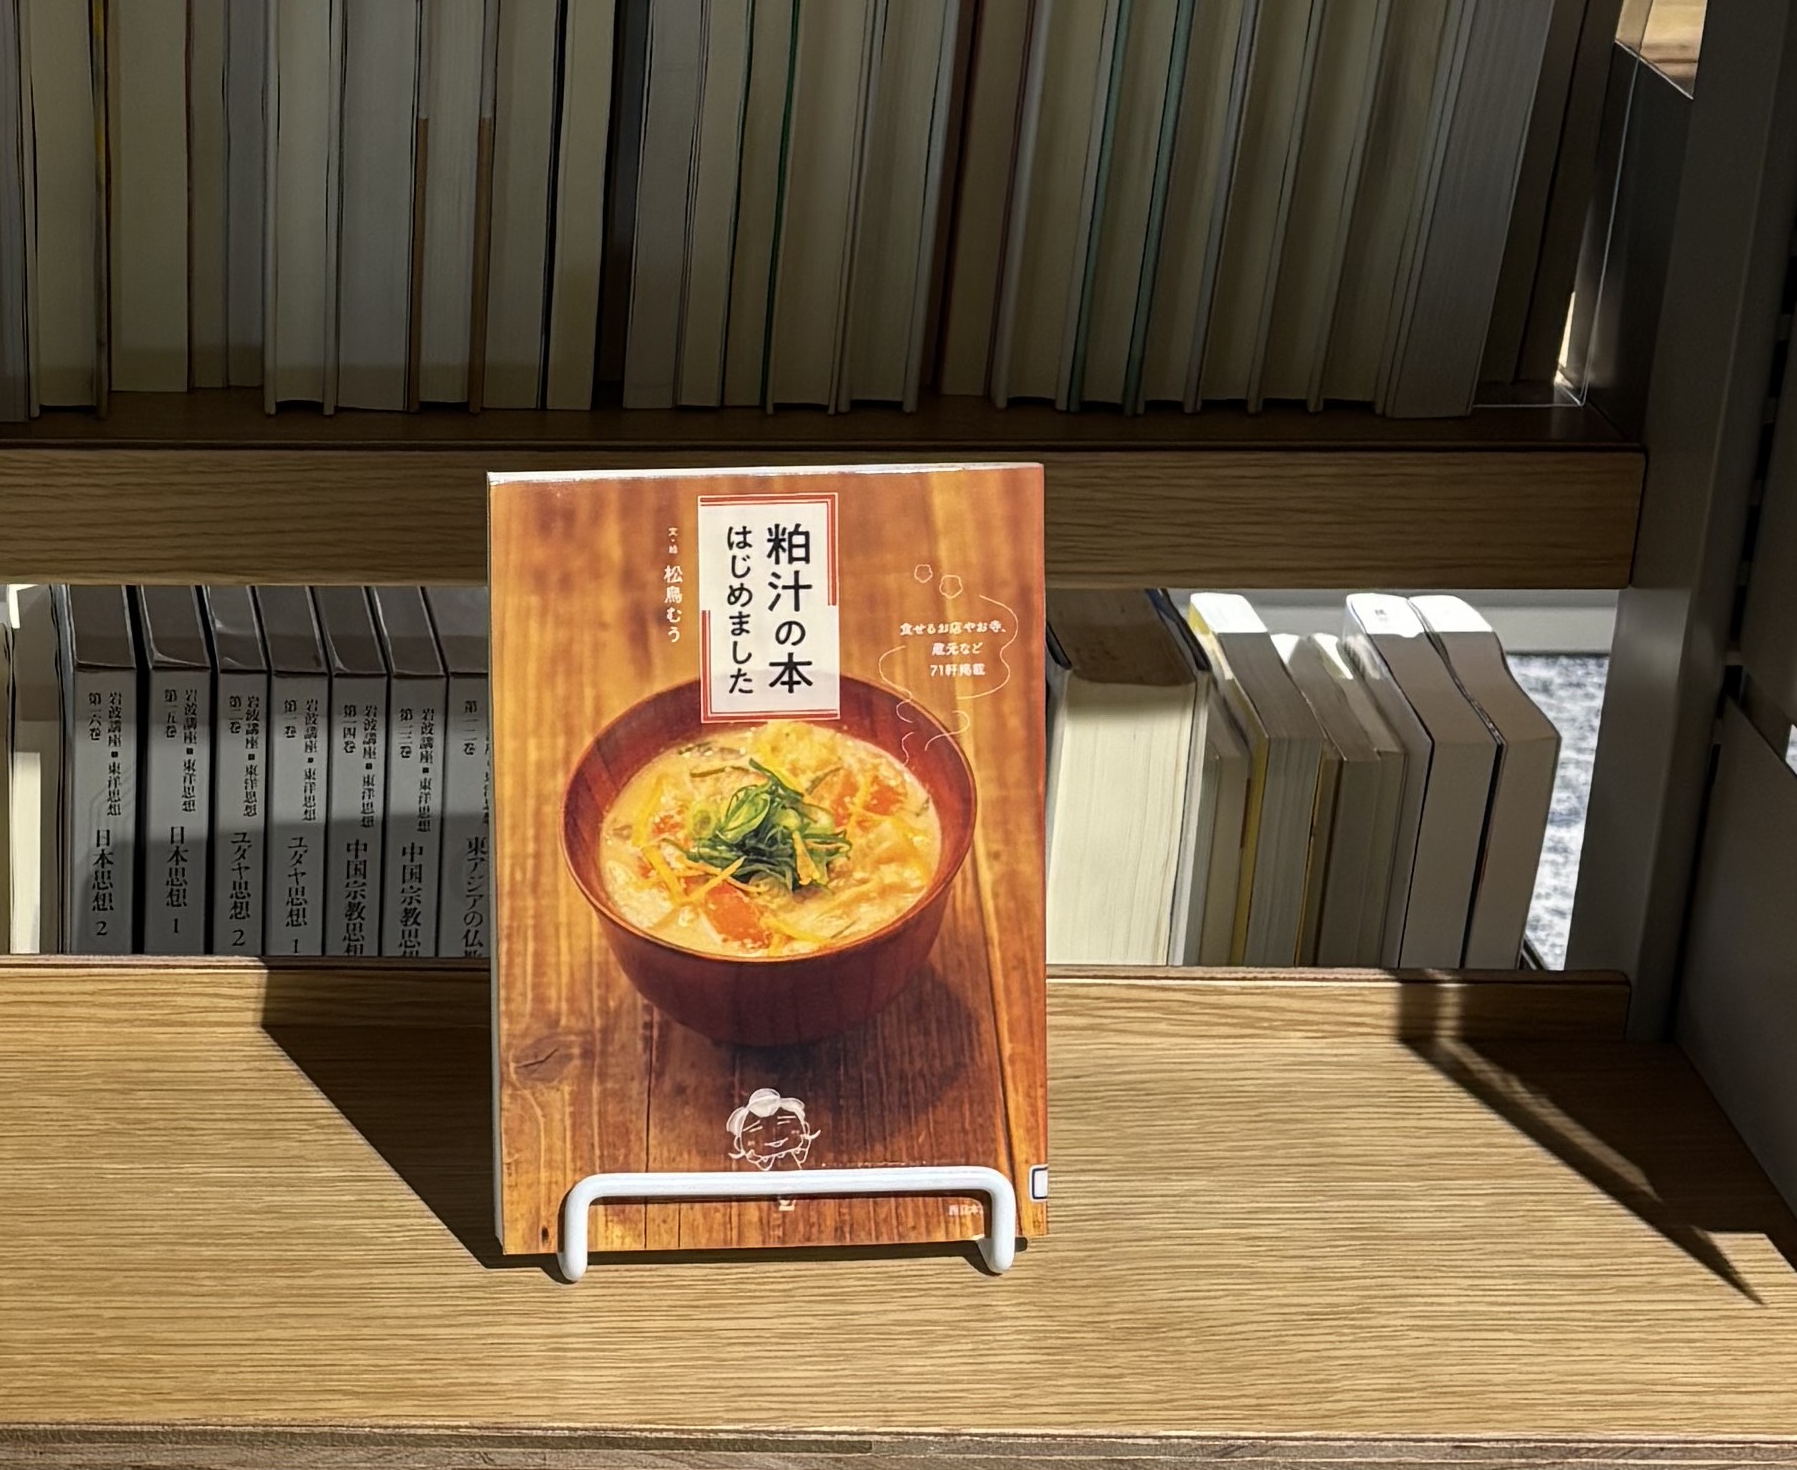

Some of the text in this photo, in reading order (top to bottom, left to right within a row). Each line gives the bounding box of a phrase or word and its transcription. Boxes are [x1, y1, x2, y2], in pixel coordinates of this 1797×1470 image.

[664, 565, 683, 643] 松鳥むう
[727, 525, 754, 694] はじめました
[766, 523, 813, 694] 粕汁の本
[92, 829, 115, 936] 日本思想 2
[165, 826, 189, 934] 日本思想 1
[229, 832, 252, 947] ユダヤ思想 2
[286, 836, 308, 954] ユダヤ思想 1
